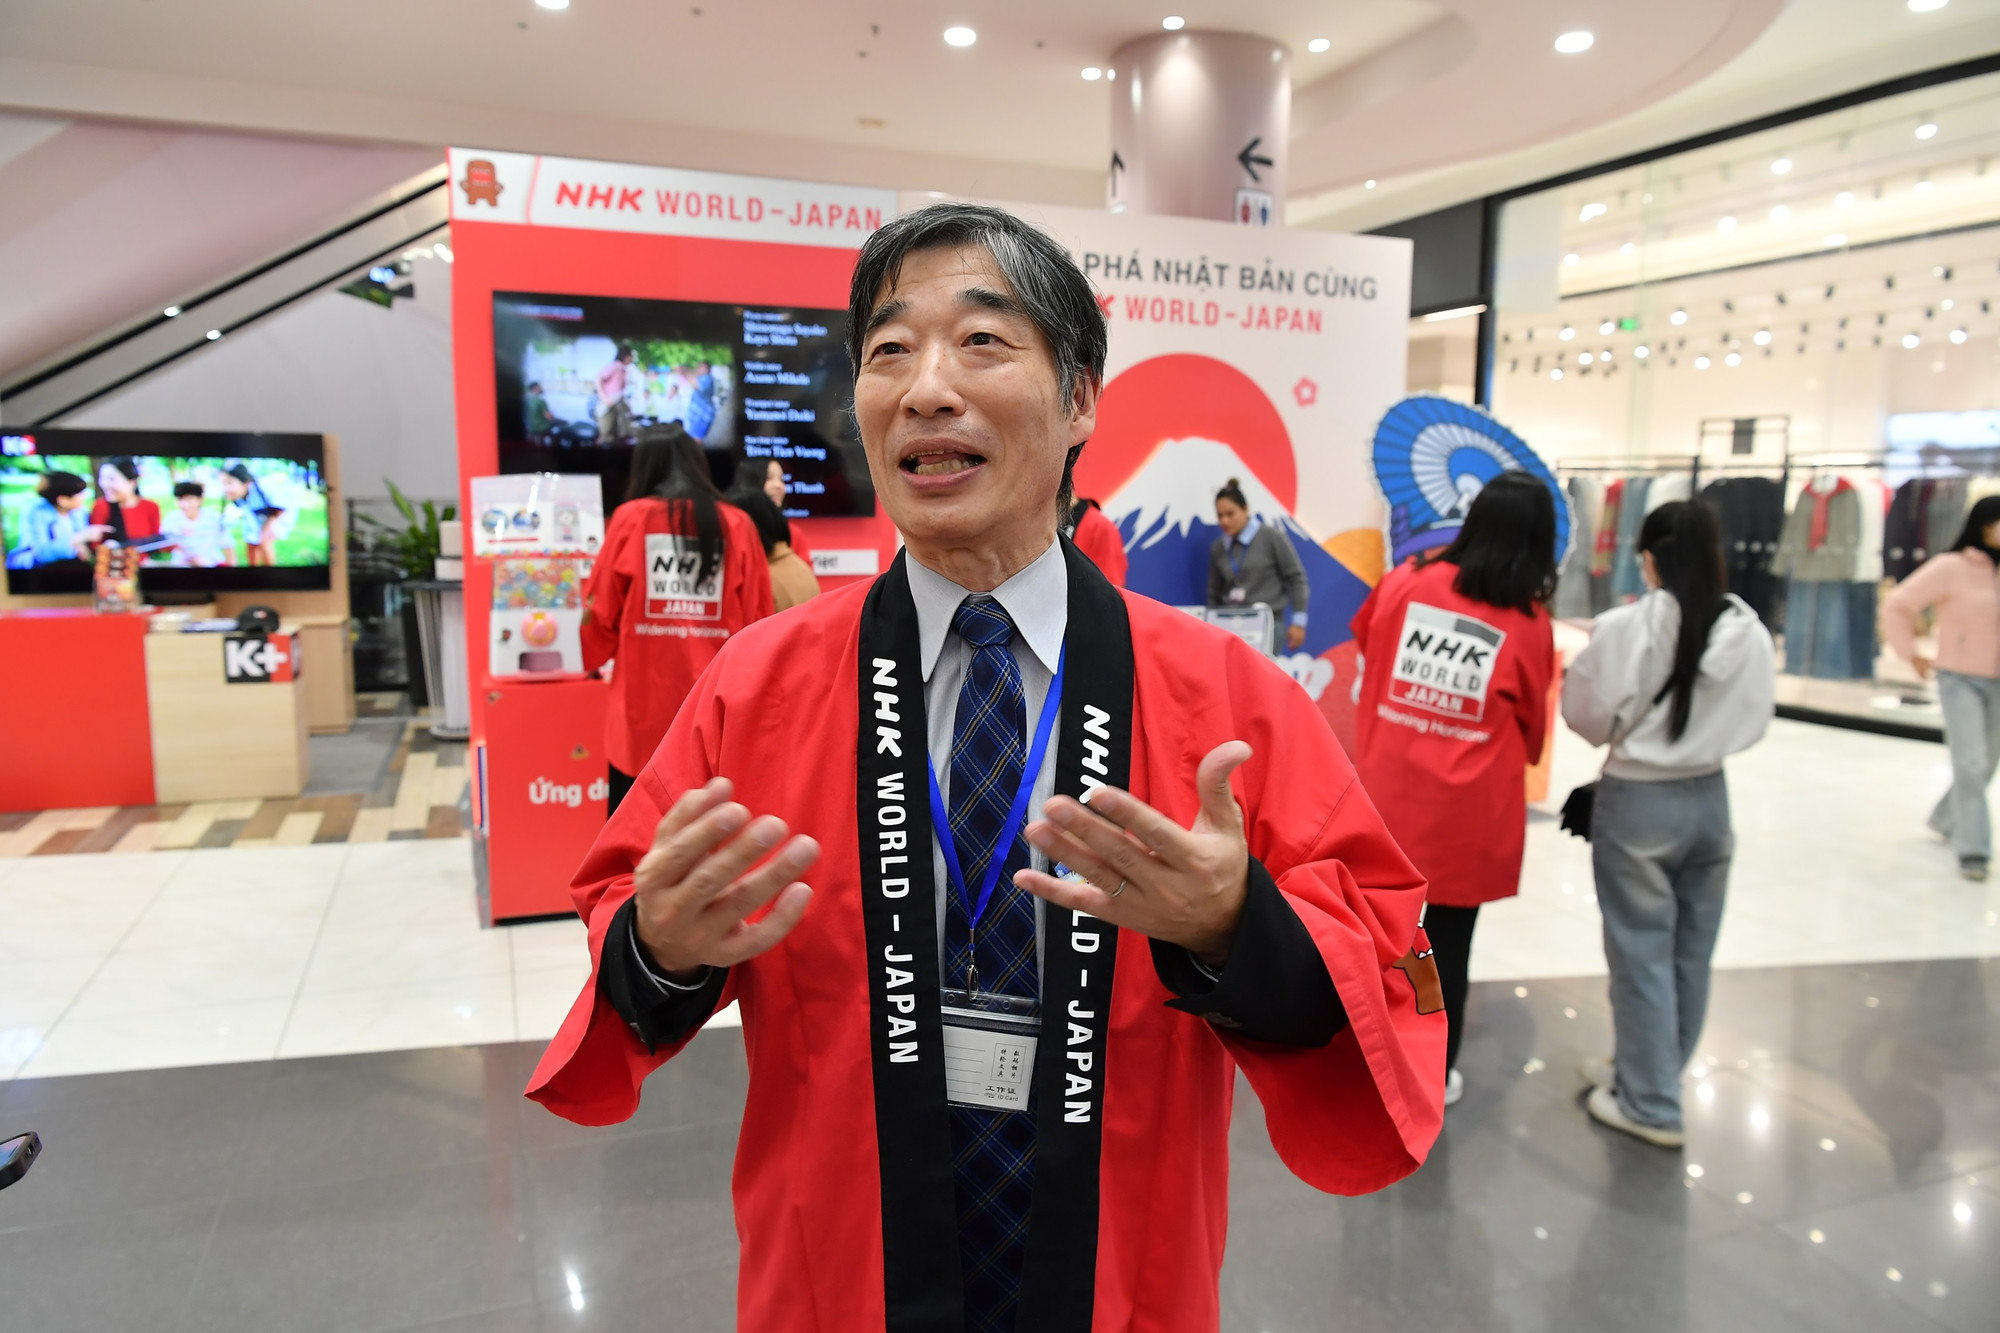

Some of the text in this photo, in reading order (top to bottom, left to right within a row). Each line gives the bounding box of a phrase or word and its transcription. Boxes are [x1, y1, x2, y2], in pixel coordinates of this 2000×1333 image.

[555, 181, 644, 212] NHK
[1084, 250, 1143, 281] PHÁ
[1239, 257, 1295, 293] BẢN
[653, 556, 719, 576] NH
[1406, 630, 1489, 667] NHK
[1401, 657, 1482, 692] WORLD
[872, 657, 902, 758] NHK
[1404, 684, 1465, 712] JAPAN
[1377, 703, 1430, 733] Wening
[528, 776, 583, 808] Ứng
[1063, 1000, 1095, 1124] JAPAN
